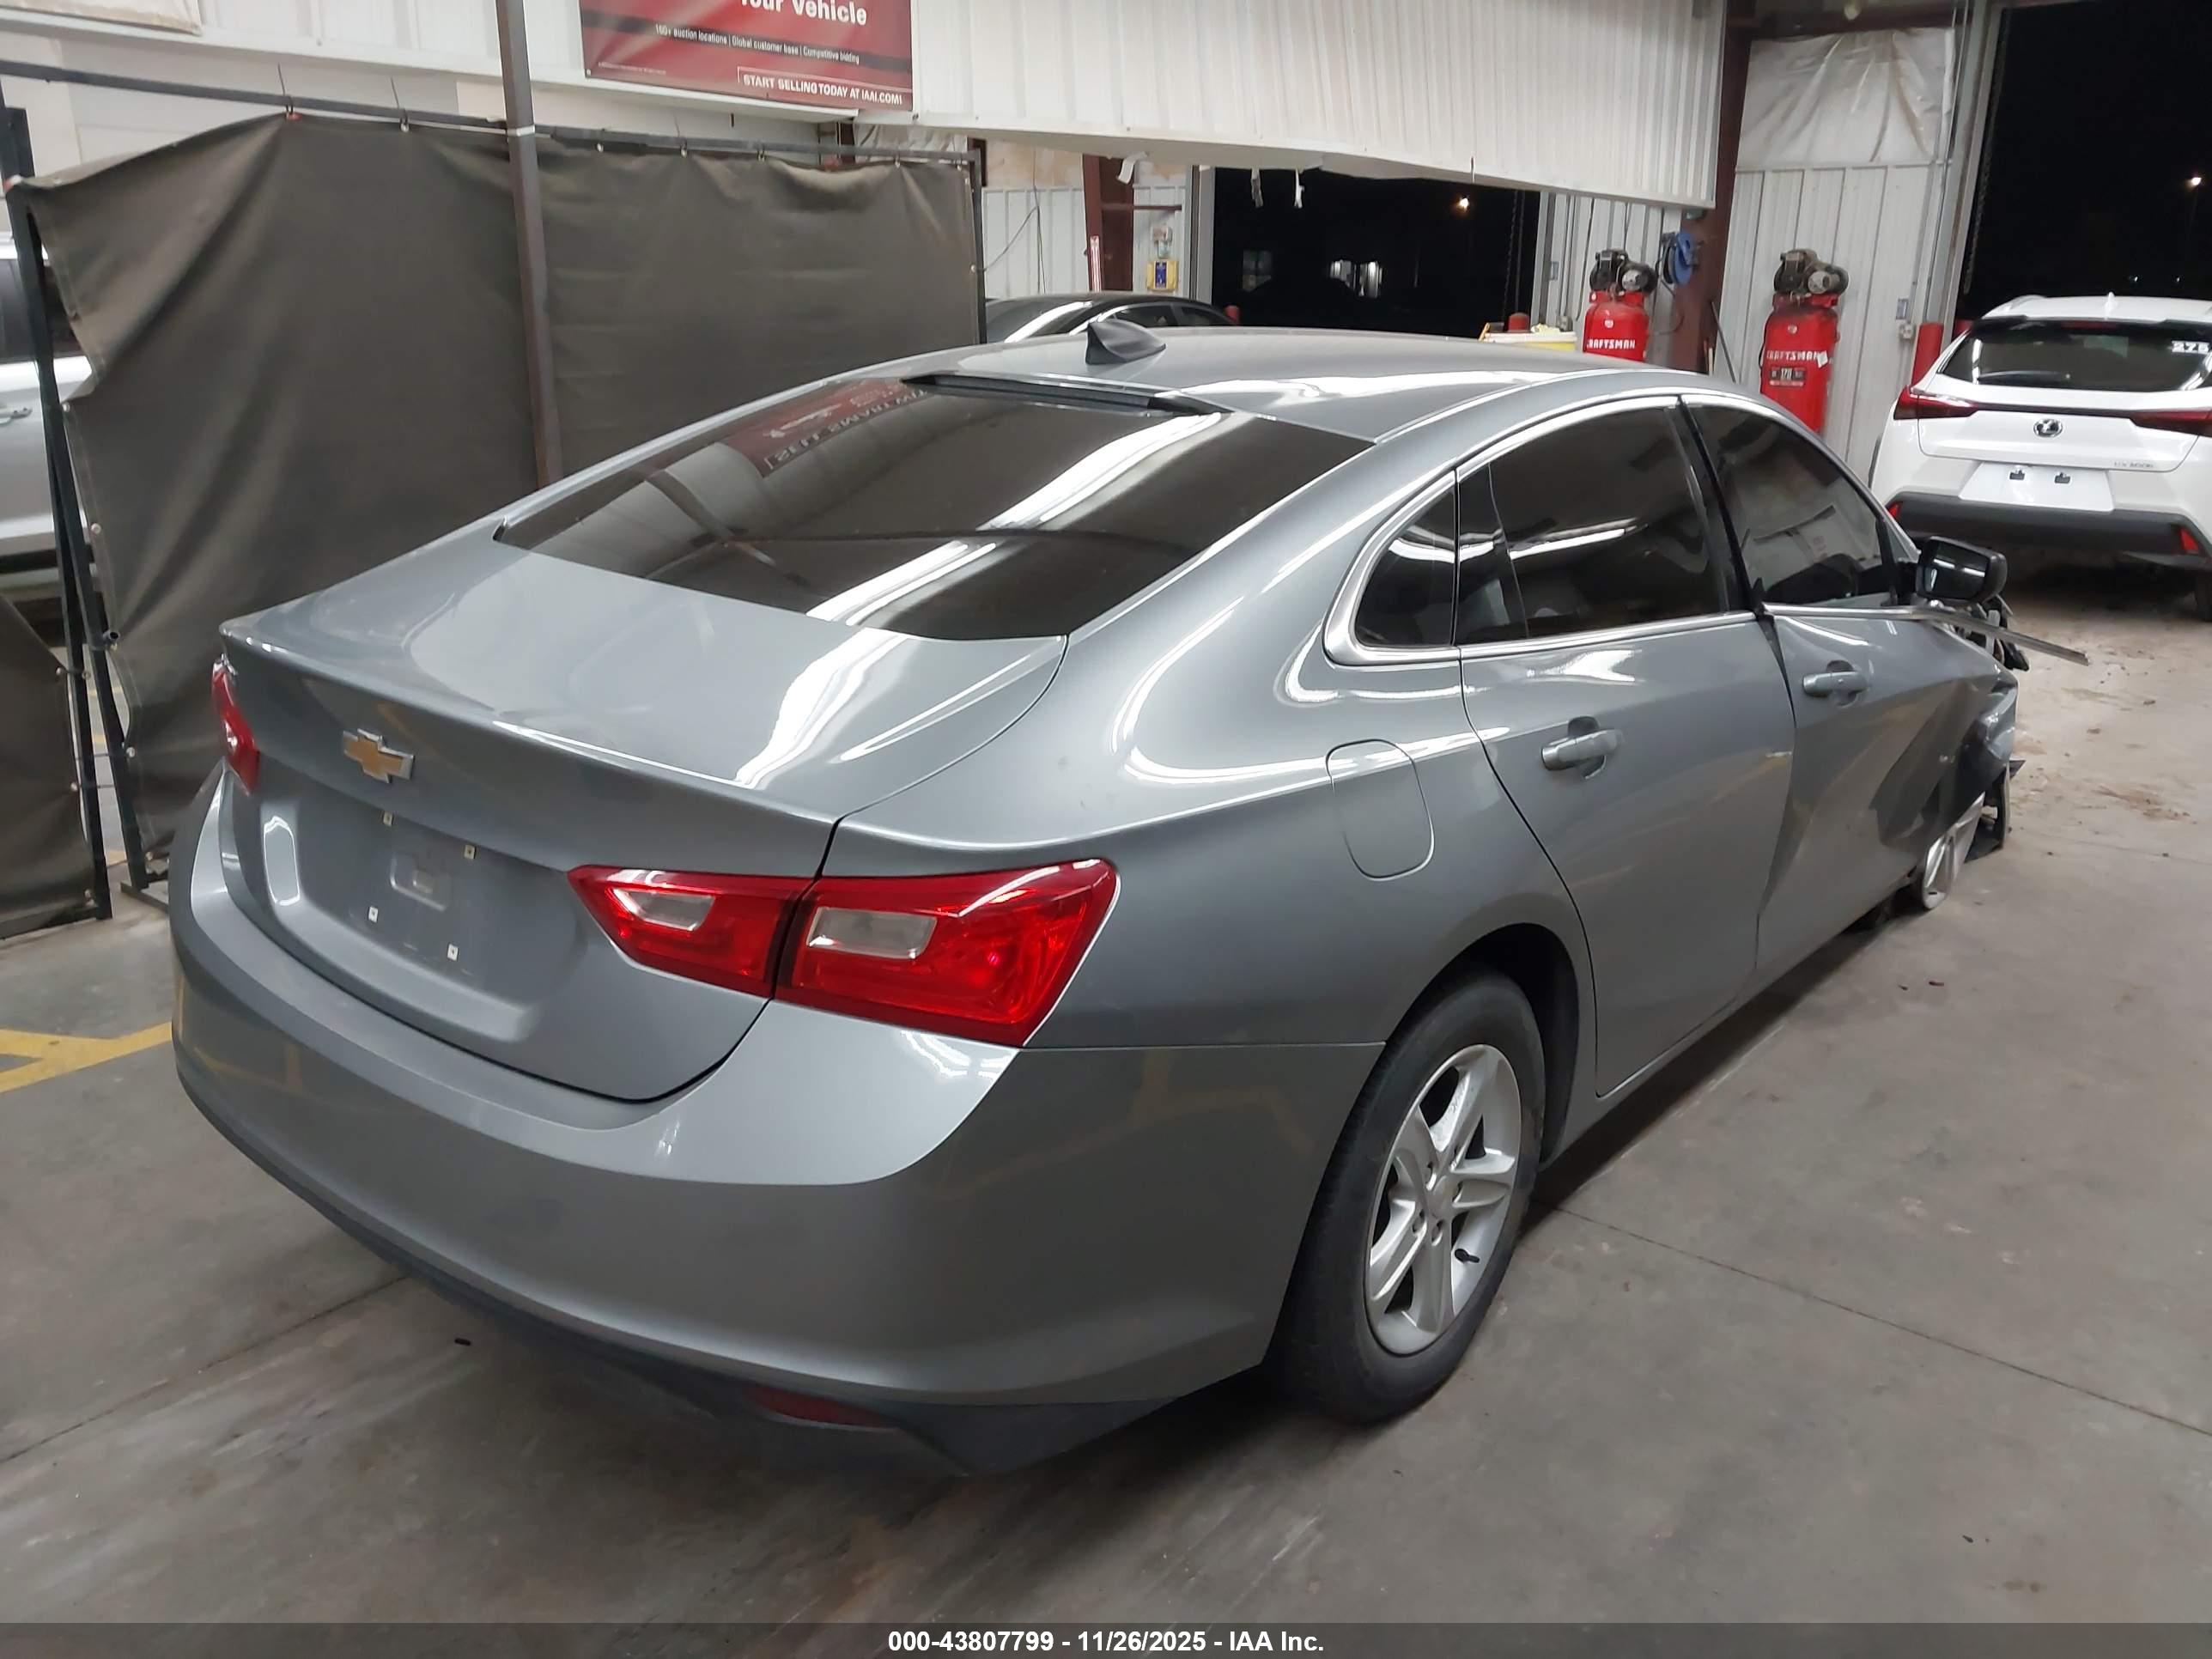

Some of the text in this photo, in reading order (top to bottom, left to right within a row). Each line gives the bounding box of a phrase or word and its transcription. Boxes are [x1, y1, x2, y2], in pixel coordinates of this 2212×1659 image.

[793, 0, 866, 26] Vehicle
[743, 74, 775, 88] START
[778, 78, 817, 94] SELLING
[818, 84, 848, 98] TODAY
[849, 88, 860, 100] AT
